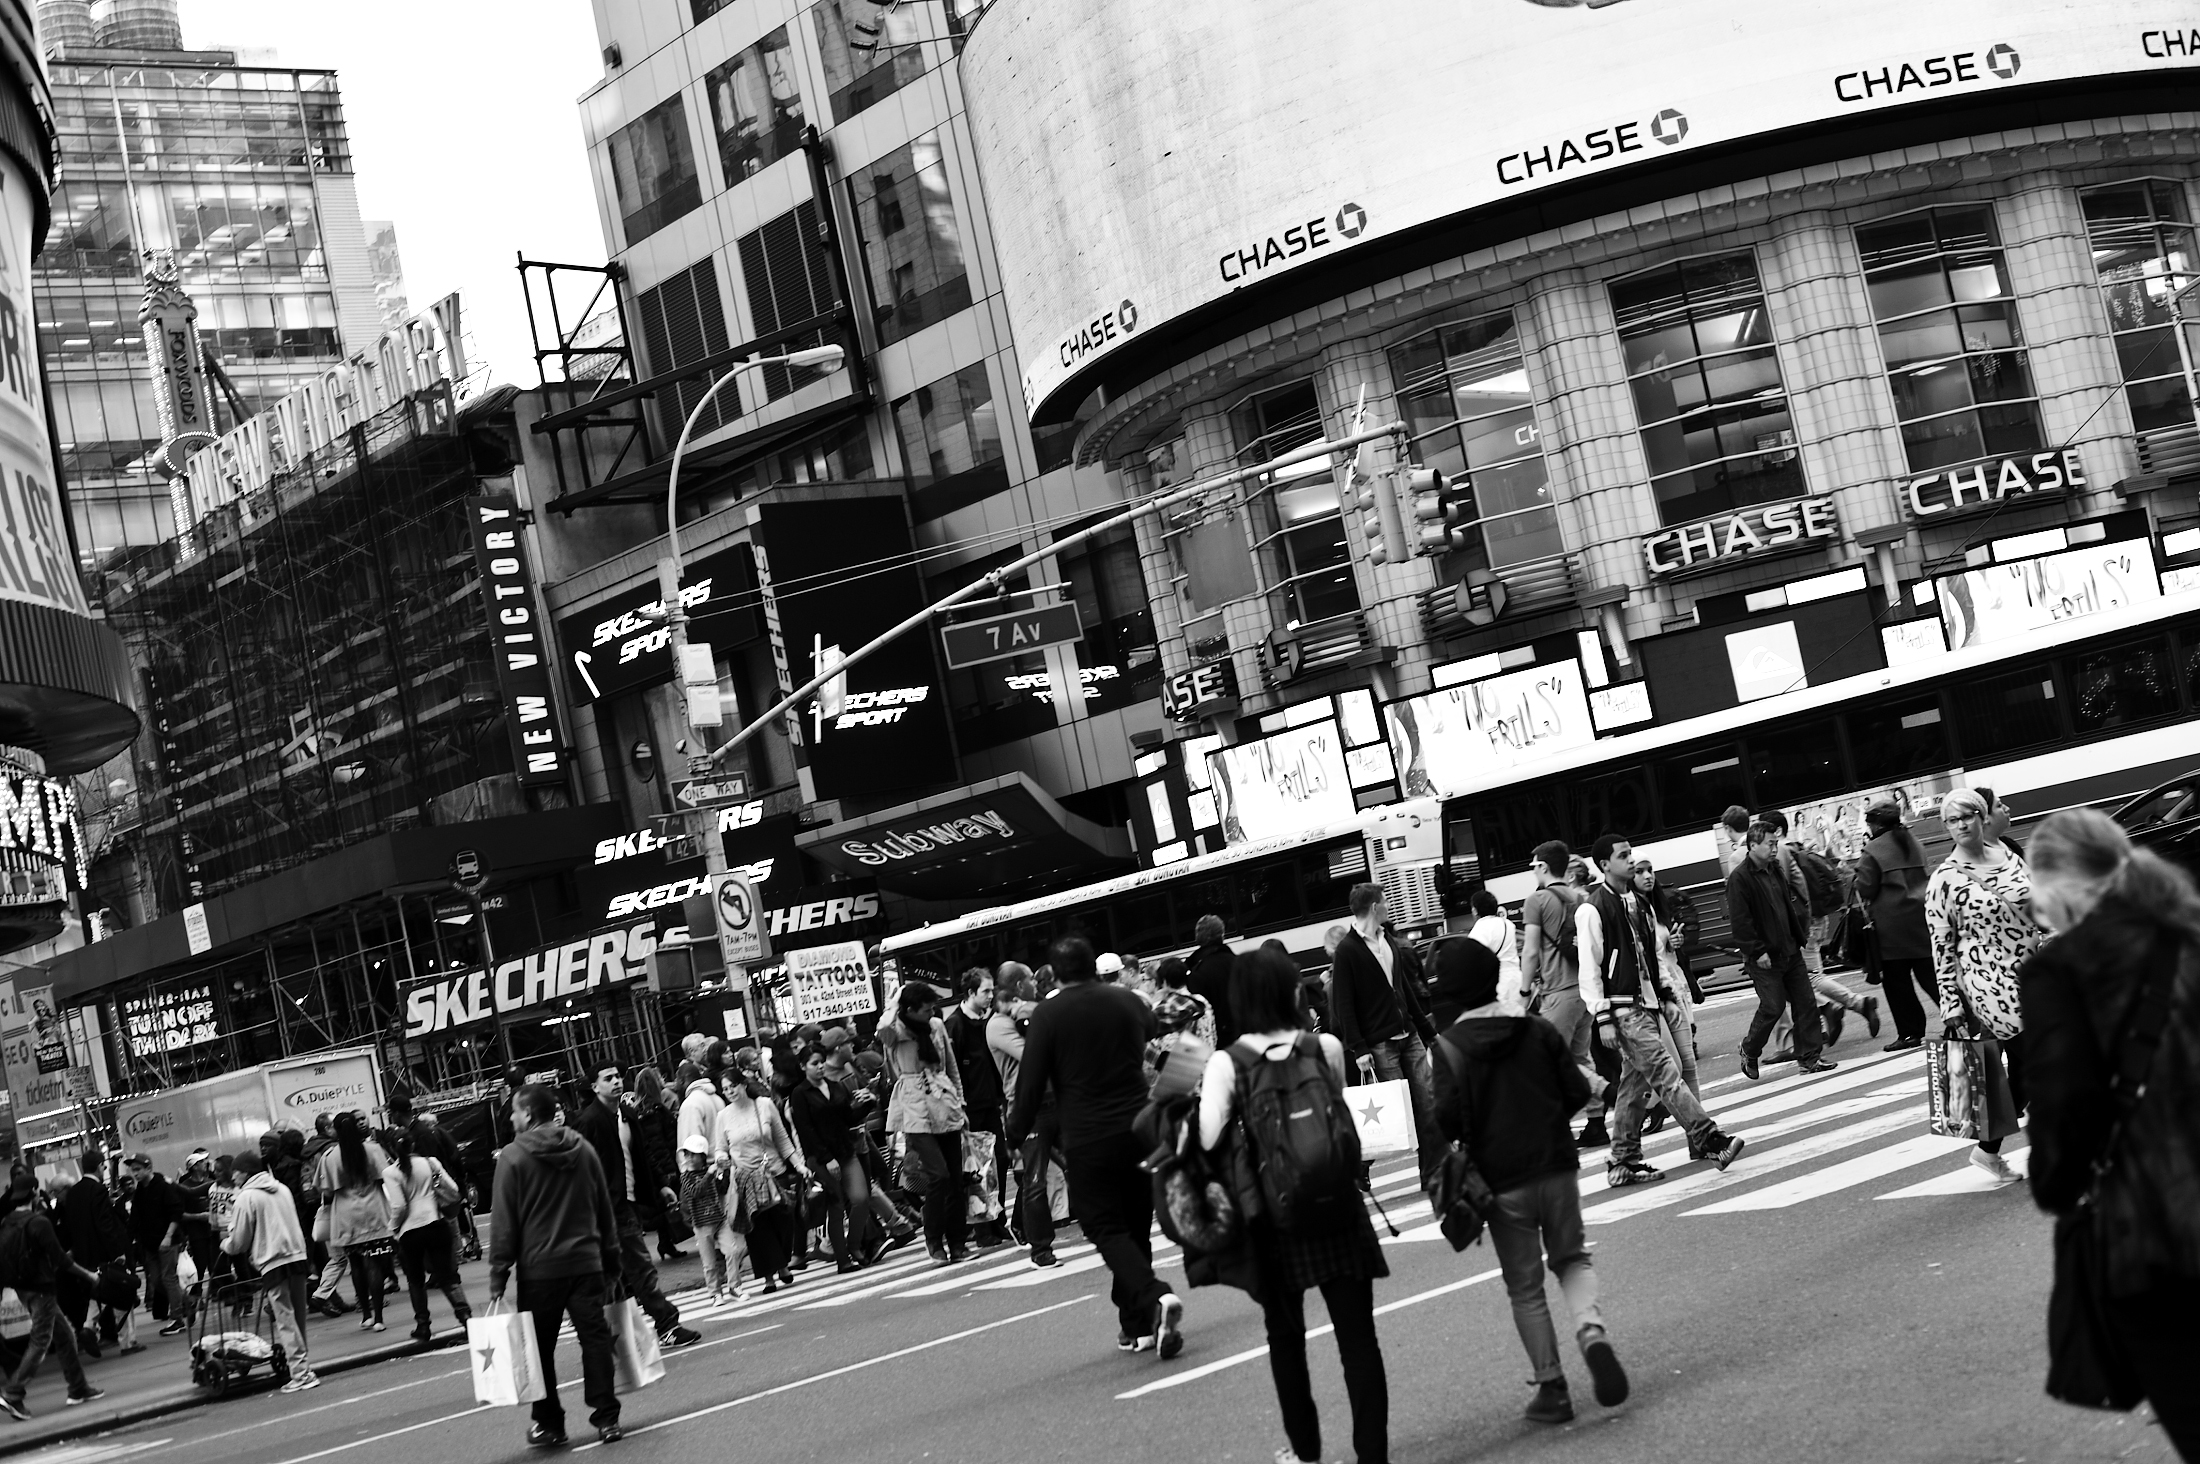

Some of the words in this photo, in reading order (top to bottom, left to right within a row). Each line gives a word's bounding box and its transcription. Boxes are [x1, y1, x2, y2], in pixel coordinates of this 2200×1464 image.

[1834, 52, 1980, 102] CHASE
[1497, 120, 1643, 185] CHASE
[1219, 217, 1331, 283] CHASE
[1060, 312, 1117, 369] CHASE
[168, 327, 198, 424] FOXWOODS
[187, 413, 272, 517] NEW
[274, 289, 468, 470] VICTORY
[1909, 448, 2088, 516] CHASE
[1646, 496, 1836, 574] CHASE
[479, 505, 540, 671] VICTORY
[986, 626, 1000, 650] 7
[523, 695, 560, 773] NEW
[835, 706, 908, 729] SPORT
[685, 787, 707, 801] ONE
[715, 782, 738, 796] WAY
[657, 818, 668, 835] 7
[676, 841, 690, 857] 42
[841, 808, 1014, 867] Subway
[481, 897, 504, 911] M42
[405, 921, 658, 1039] SKECHERS
[794, 962, 866, 992] TATTOOS
[797, 945, 857, 968] DIAMOND
[165, 1020, 220, 1051] DARK
[177, 1001, 214, 1025] OFF
[803, 998, 871, 1020] 917-940-9162
[1928, 1042, 1943, 1133] Abercrombie
